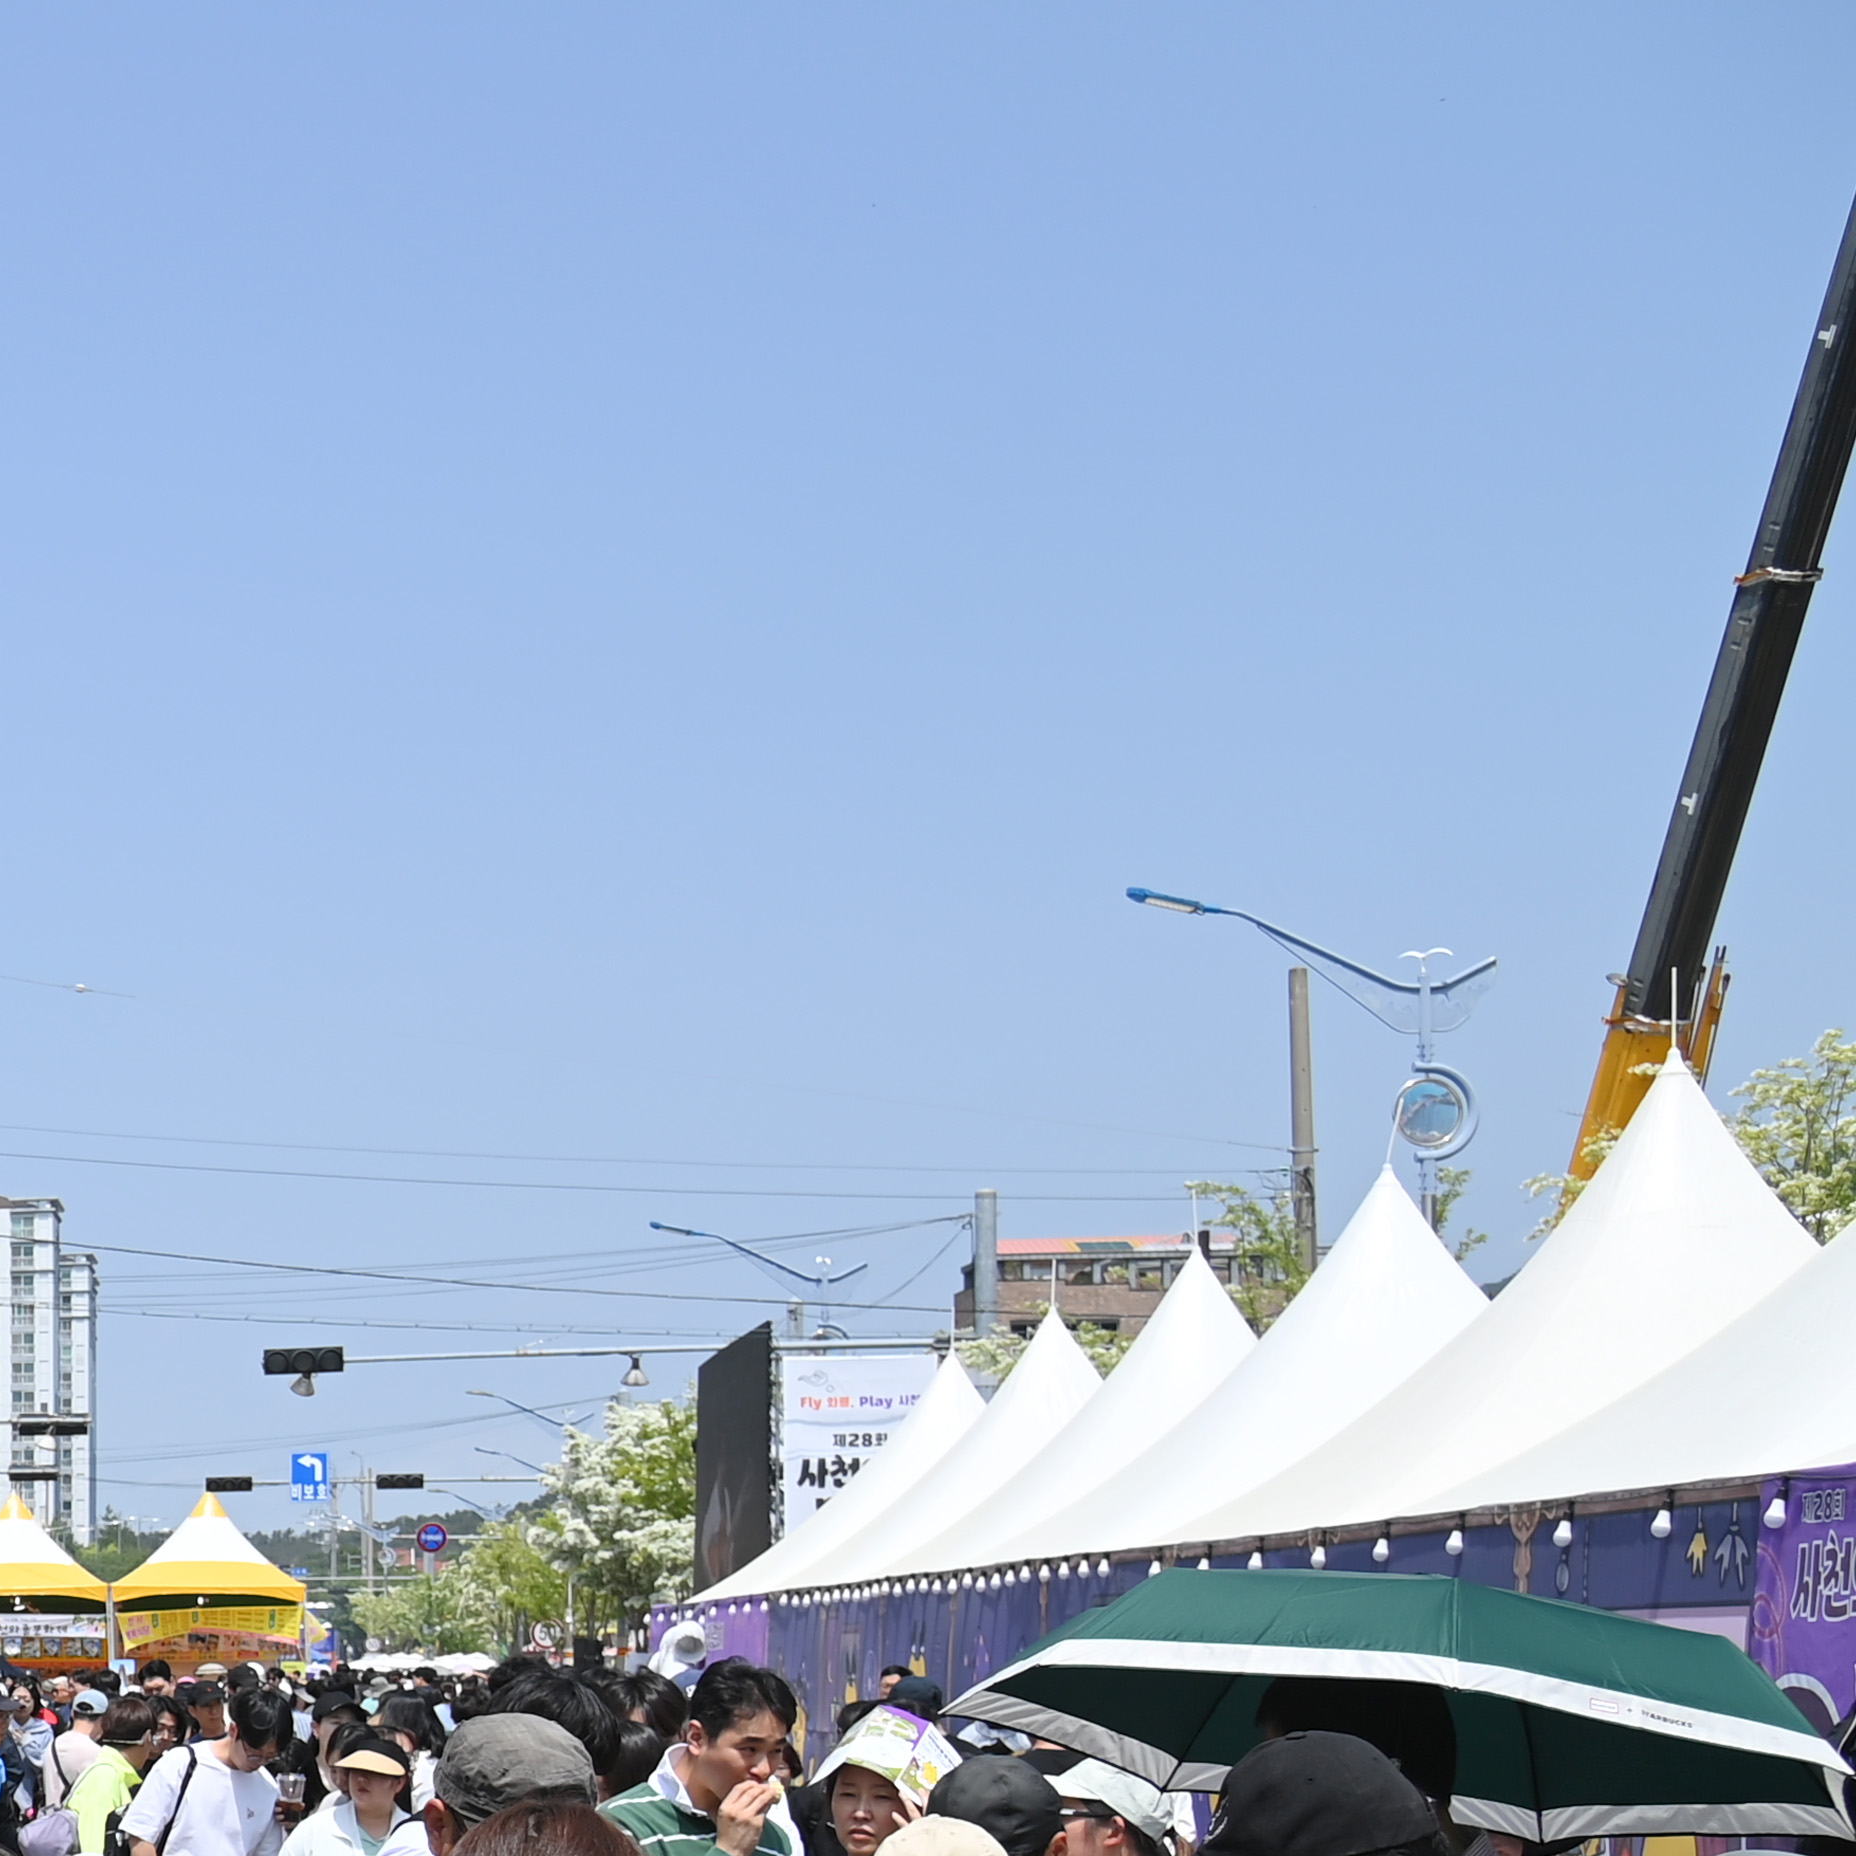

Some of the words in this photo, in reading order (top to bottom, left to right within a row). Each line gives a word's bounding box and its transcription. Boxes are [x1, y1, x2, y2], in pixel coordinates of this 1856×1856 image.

[800, 1397, 822, 1410] Fly
[859, 1396, 893, 1409] Play
[832, 1433, 888, 1447] 제28회
[291, 1483, 328, 1500] 비보호
[1801, 1489, 1845, 1523] 제28회
[1790, 1530, 1856, 1622] 사천
[1641, 1709, 1693, 1728] STARBUCKS
